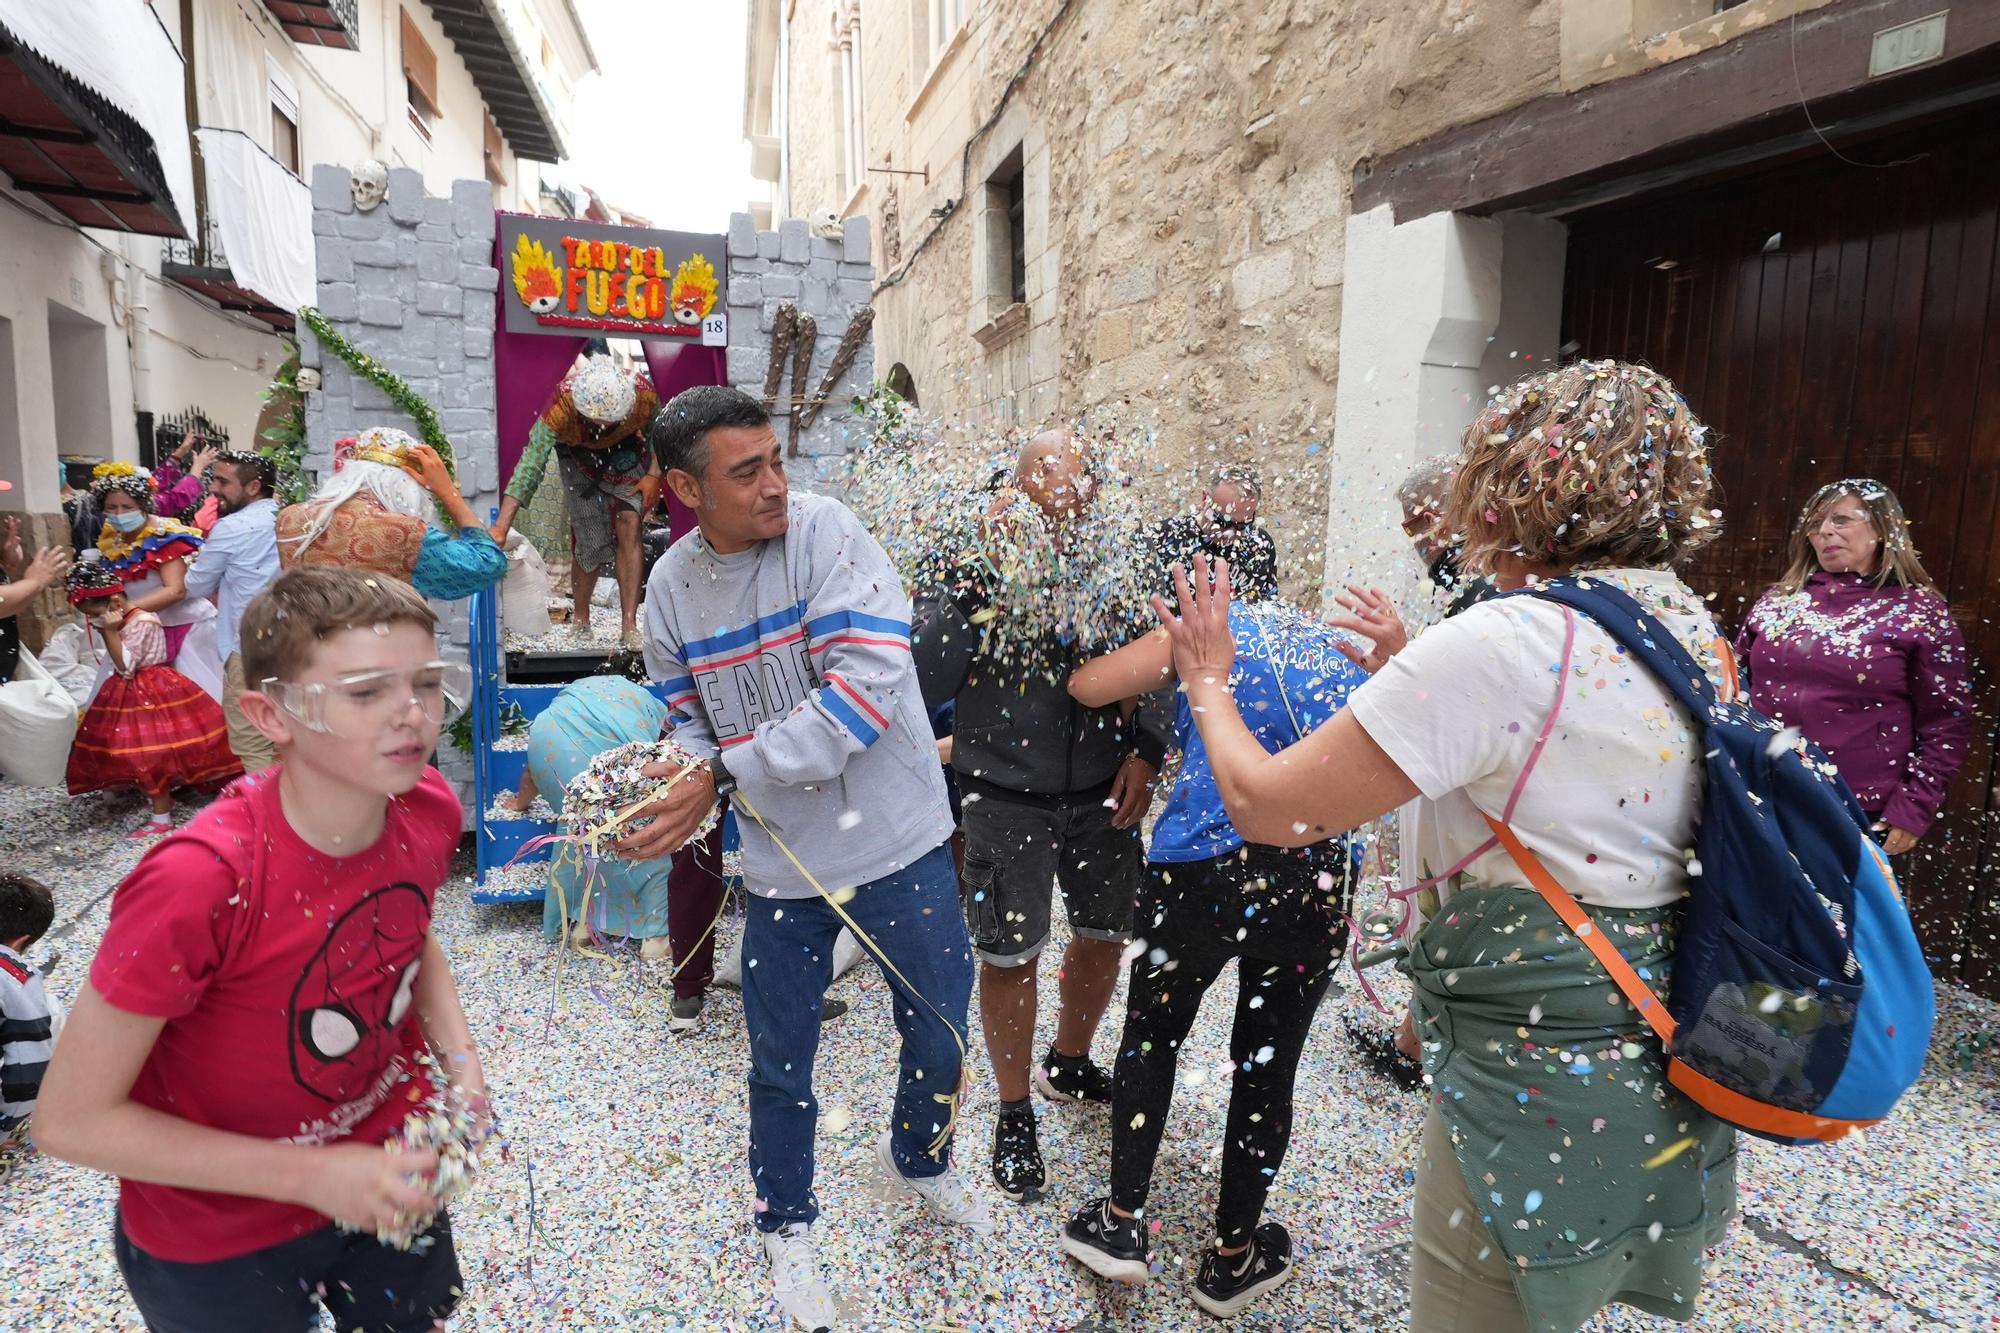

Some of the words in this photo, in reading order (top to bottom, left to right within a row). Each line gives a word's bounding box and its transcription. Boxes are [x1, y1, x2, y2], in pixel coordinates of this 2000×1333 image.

[560, 235, 630, 272] TAROT
[630, 246, 671, 279] DEL
[566, 267, 666, 320] FUEGO
[706, 319, 723, 333] 18
